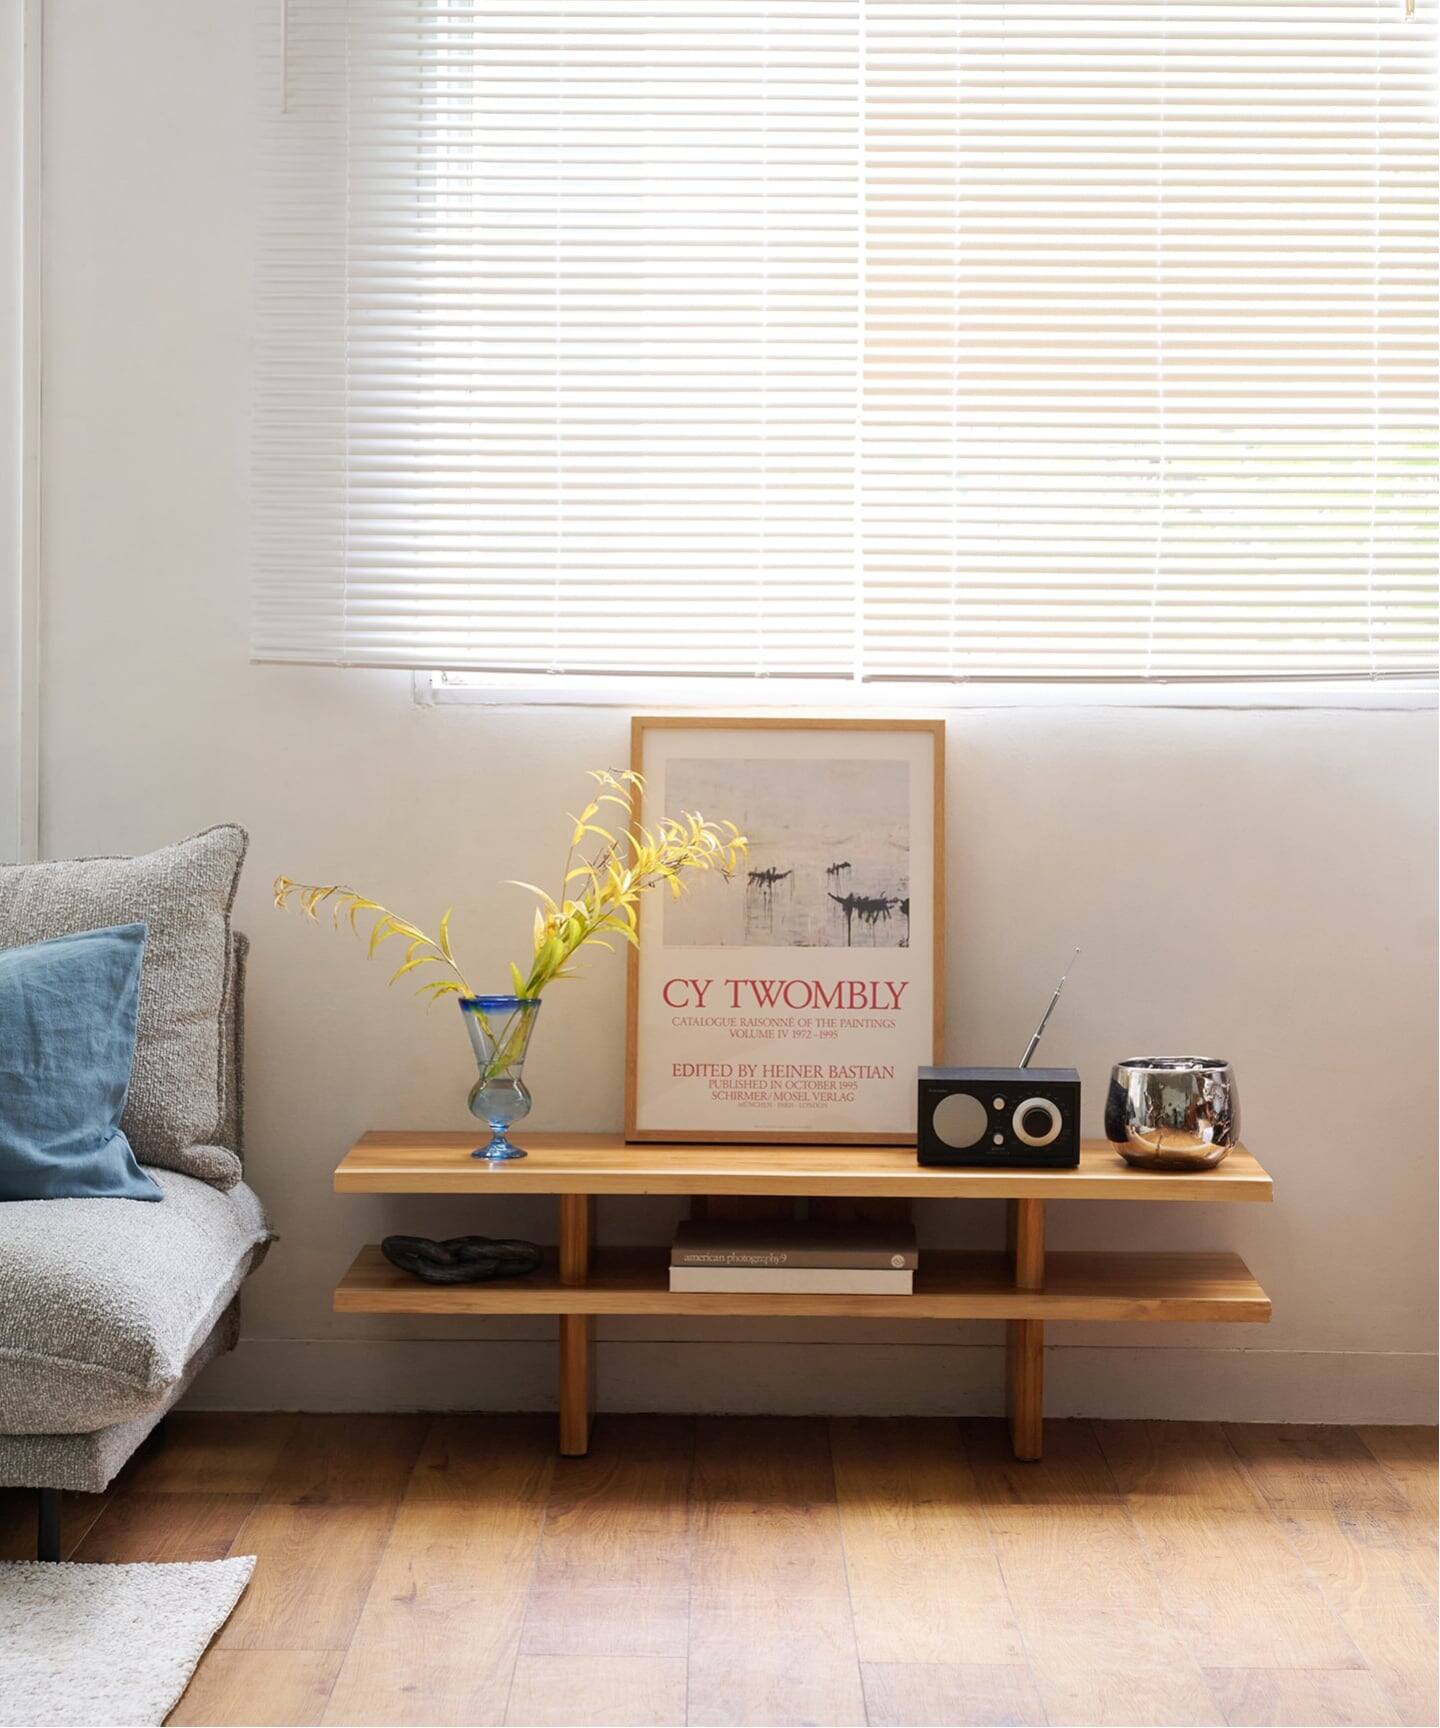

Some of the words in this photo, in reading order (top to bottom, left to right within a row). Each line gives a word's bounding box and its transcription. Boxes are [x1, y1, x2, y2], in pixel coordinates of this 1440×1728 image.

[662, 978, 714, 1009] CY
[724, 978, 909, 1010] TWOMBLY
[671, 1016, 737, 1027] CATALOGUE
[740, 1016, 795, 1028] RAISONNÉ
[797, 1017, 813, 1028] OF
[815, 1018, 837, 1028] THE
[839, 1018, 897, 1029] PAINTINGS
[729, 1028, 775, 1039] VOLUME
[777, 1029, 789, 1039] IV
[672, 1063, 733, 1077] EDITED
[737, 1064, 757, 1078] BY
[761, 1064, 824, 1078] HEINER
[828, 1064, 895, 1079] BASTIAN
[708, 1079, 768, 1089] PUBLISHED
[770, 1080, 782, 1089] IN
[785, 1080, 837, 1090] OCTOBER
[839, 1081, 859, 1090] 1995
[812, 1091, 855, 1102] VERLAG
[683, 1252, 726, 1263] american
